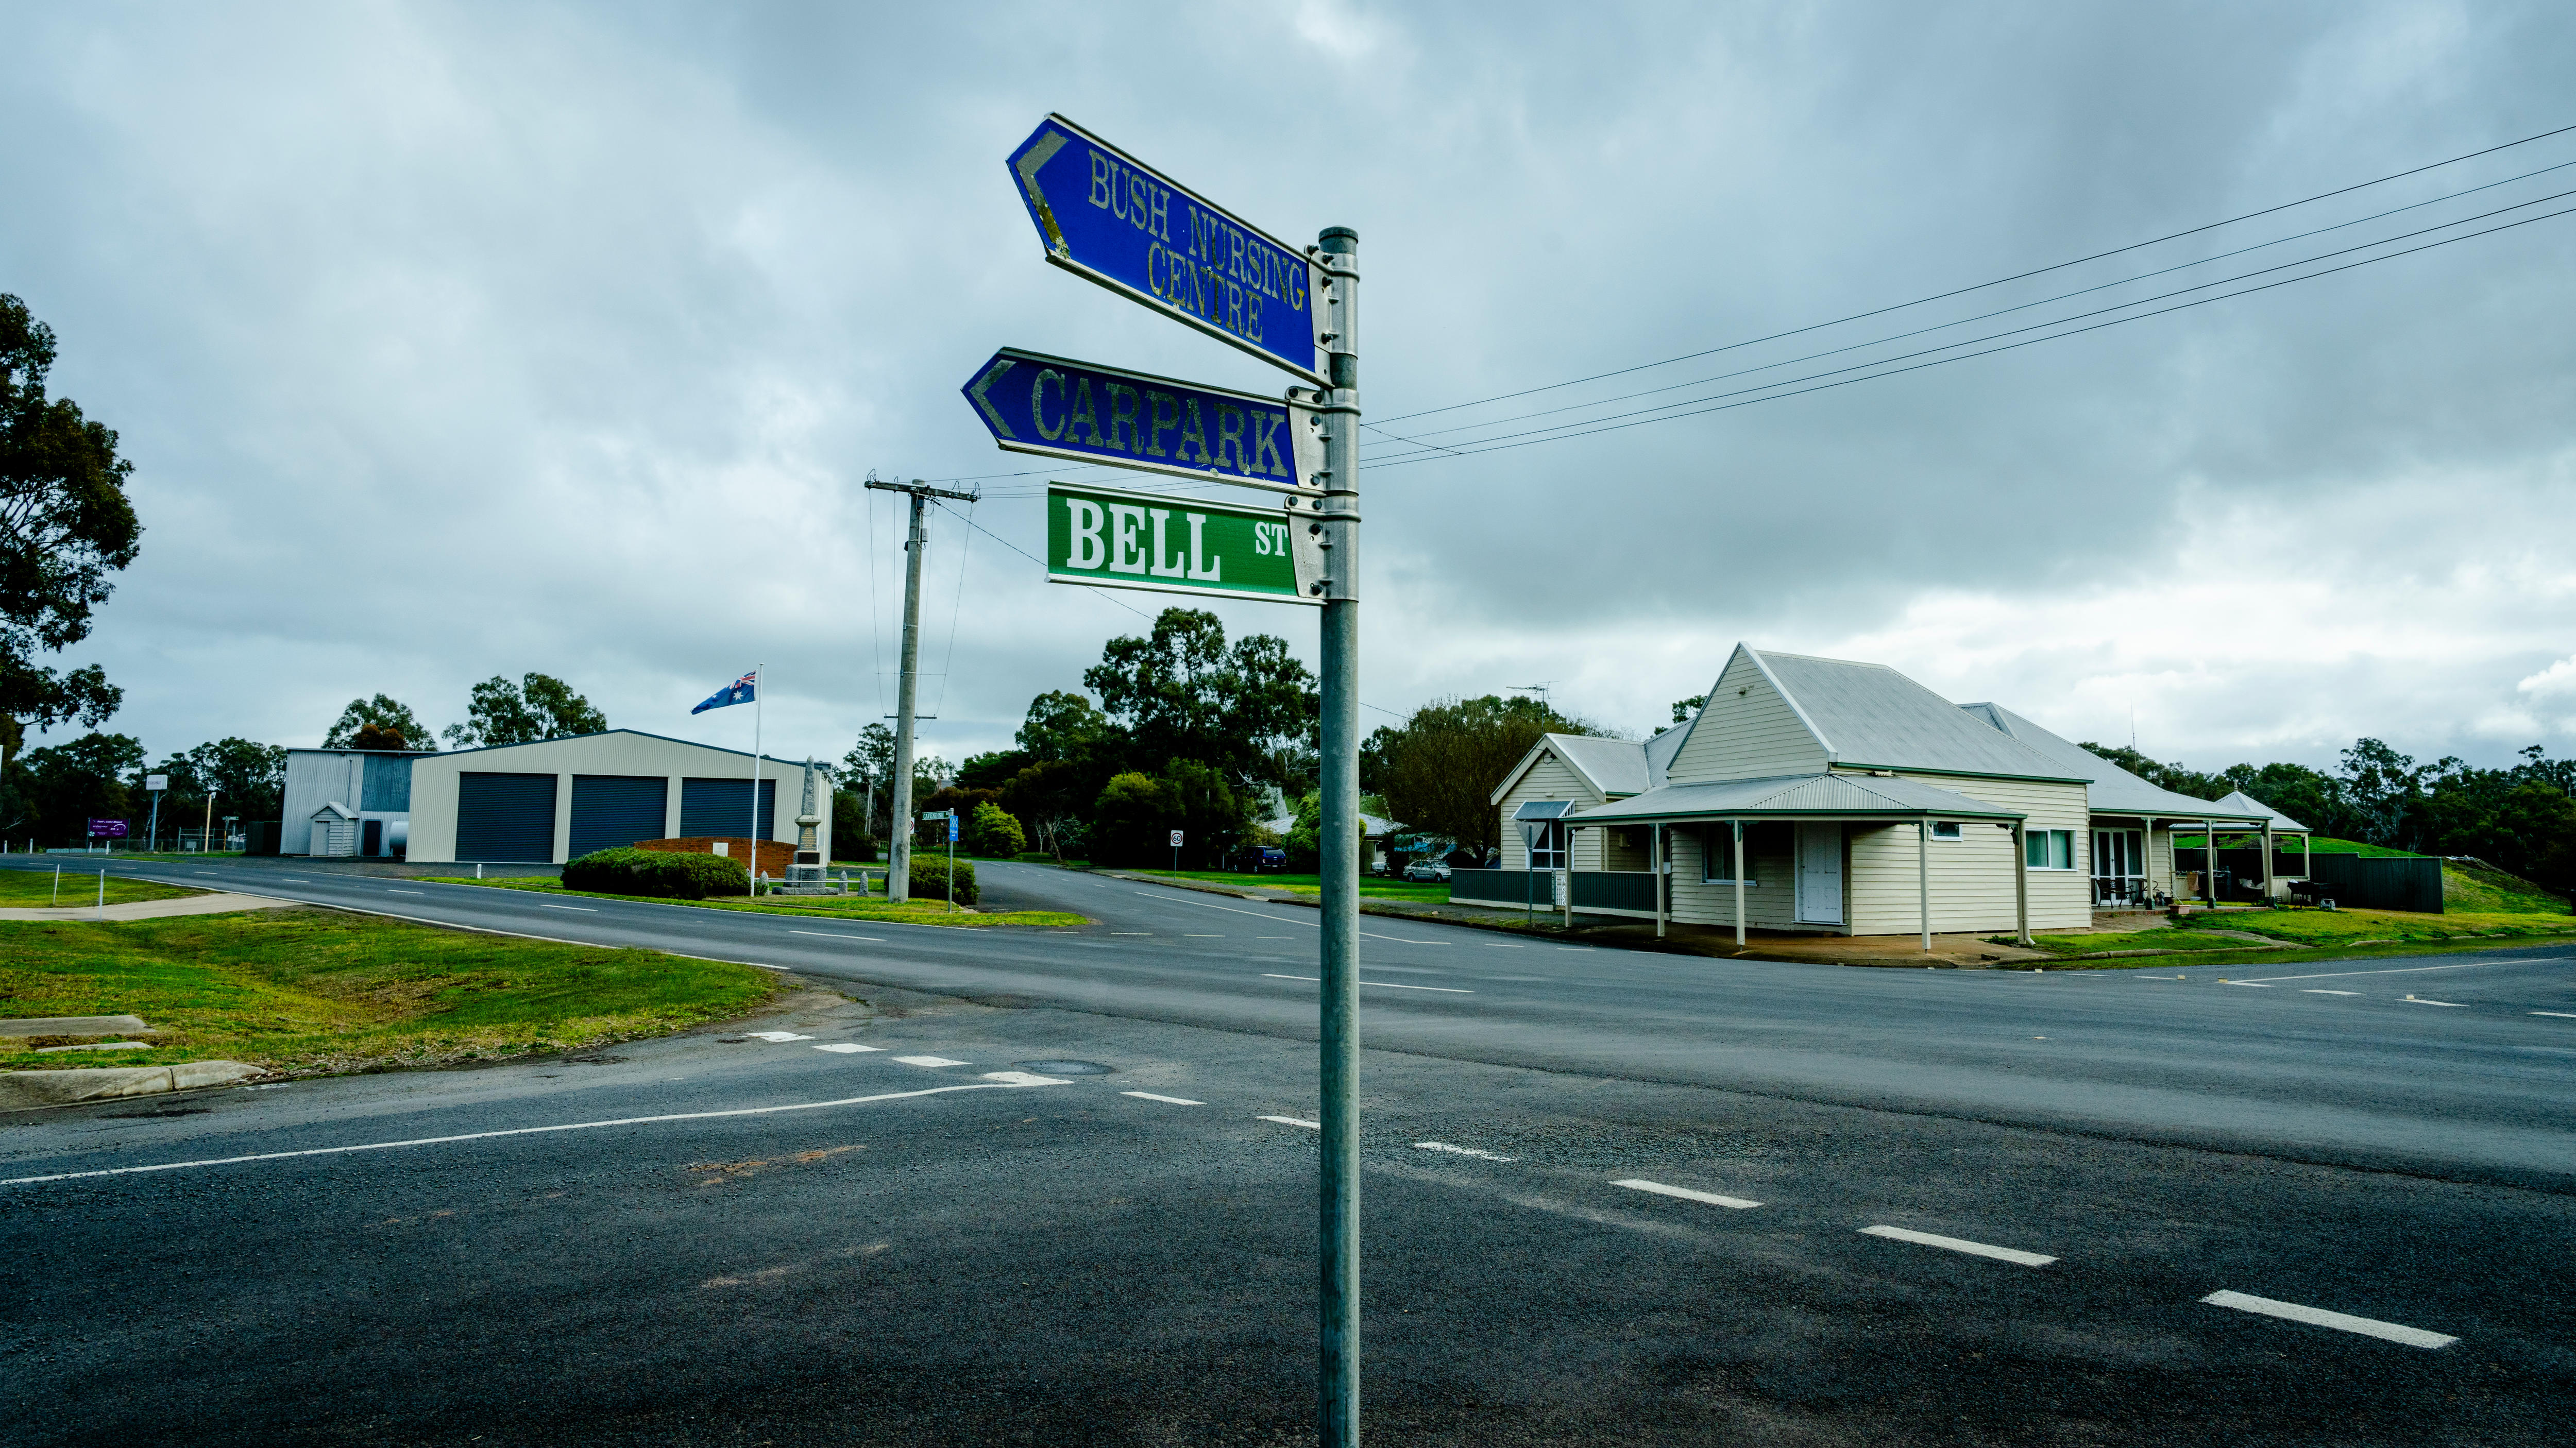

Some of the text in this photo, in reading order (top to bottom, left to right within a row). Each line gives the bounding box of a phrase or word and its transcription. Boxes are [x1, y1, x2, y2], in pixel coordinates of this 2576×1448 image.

[1089, 148, 1304, 312] BUSH NURSING
[1148, 241, 1262, 344] CENTRE
[1032, 368, 1288, 477] CARPARK
[1066, 498, 1288, 582] BELL ST
